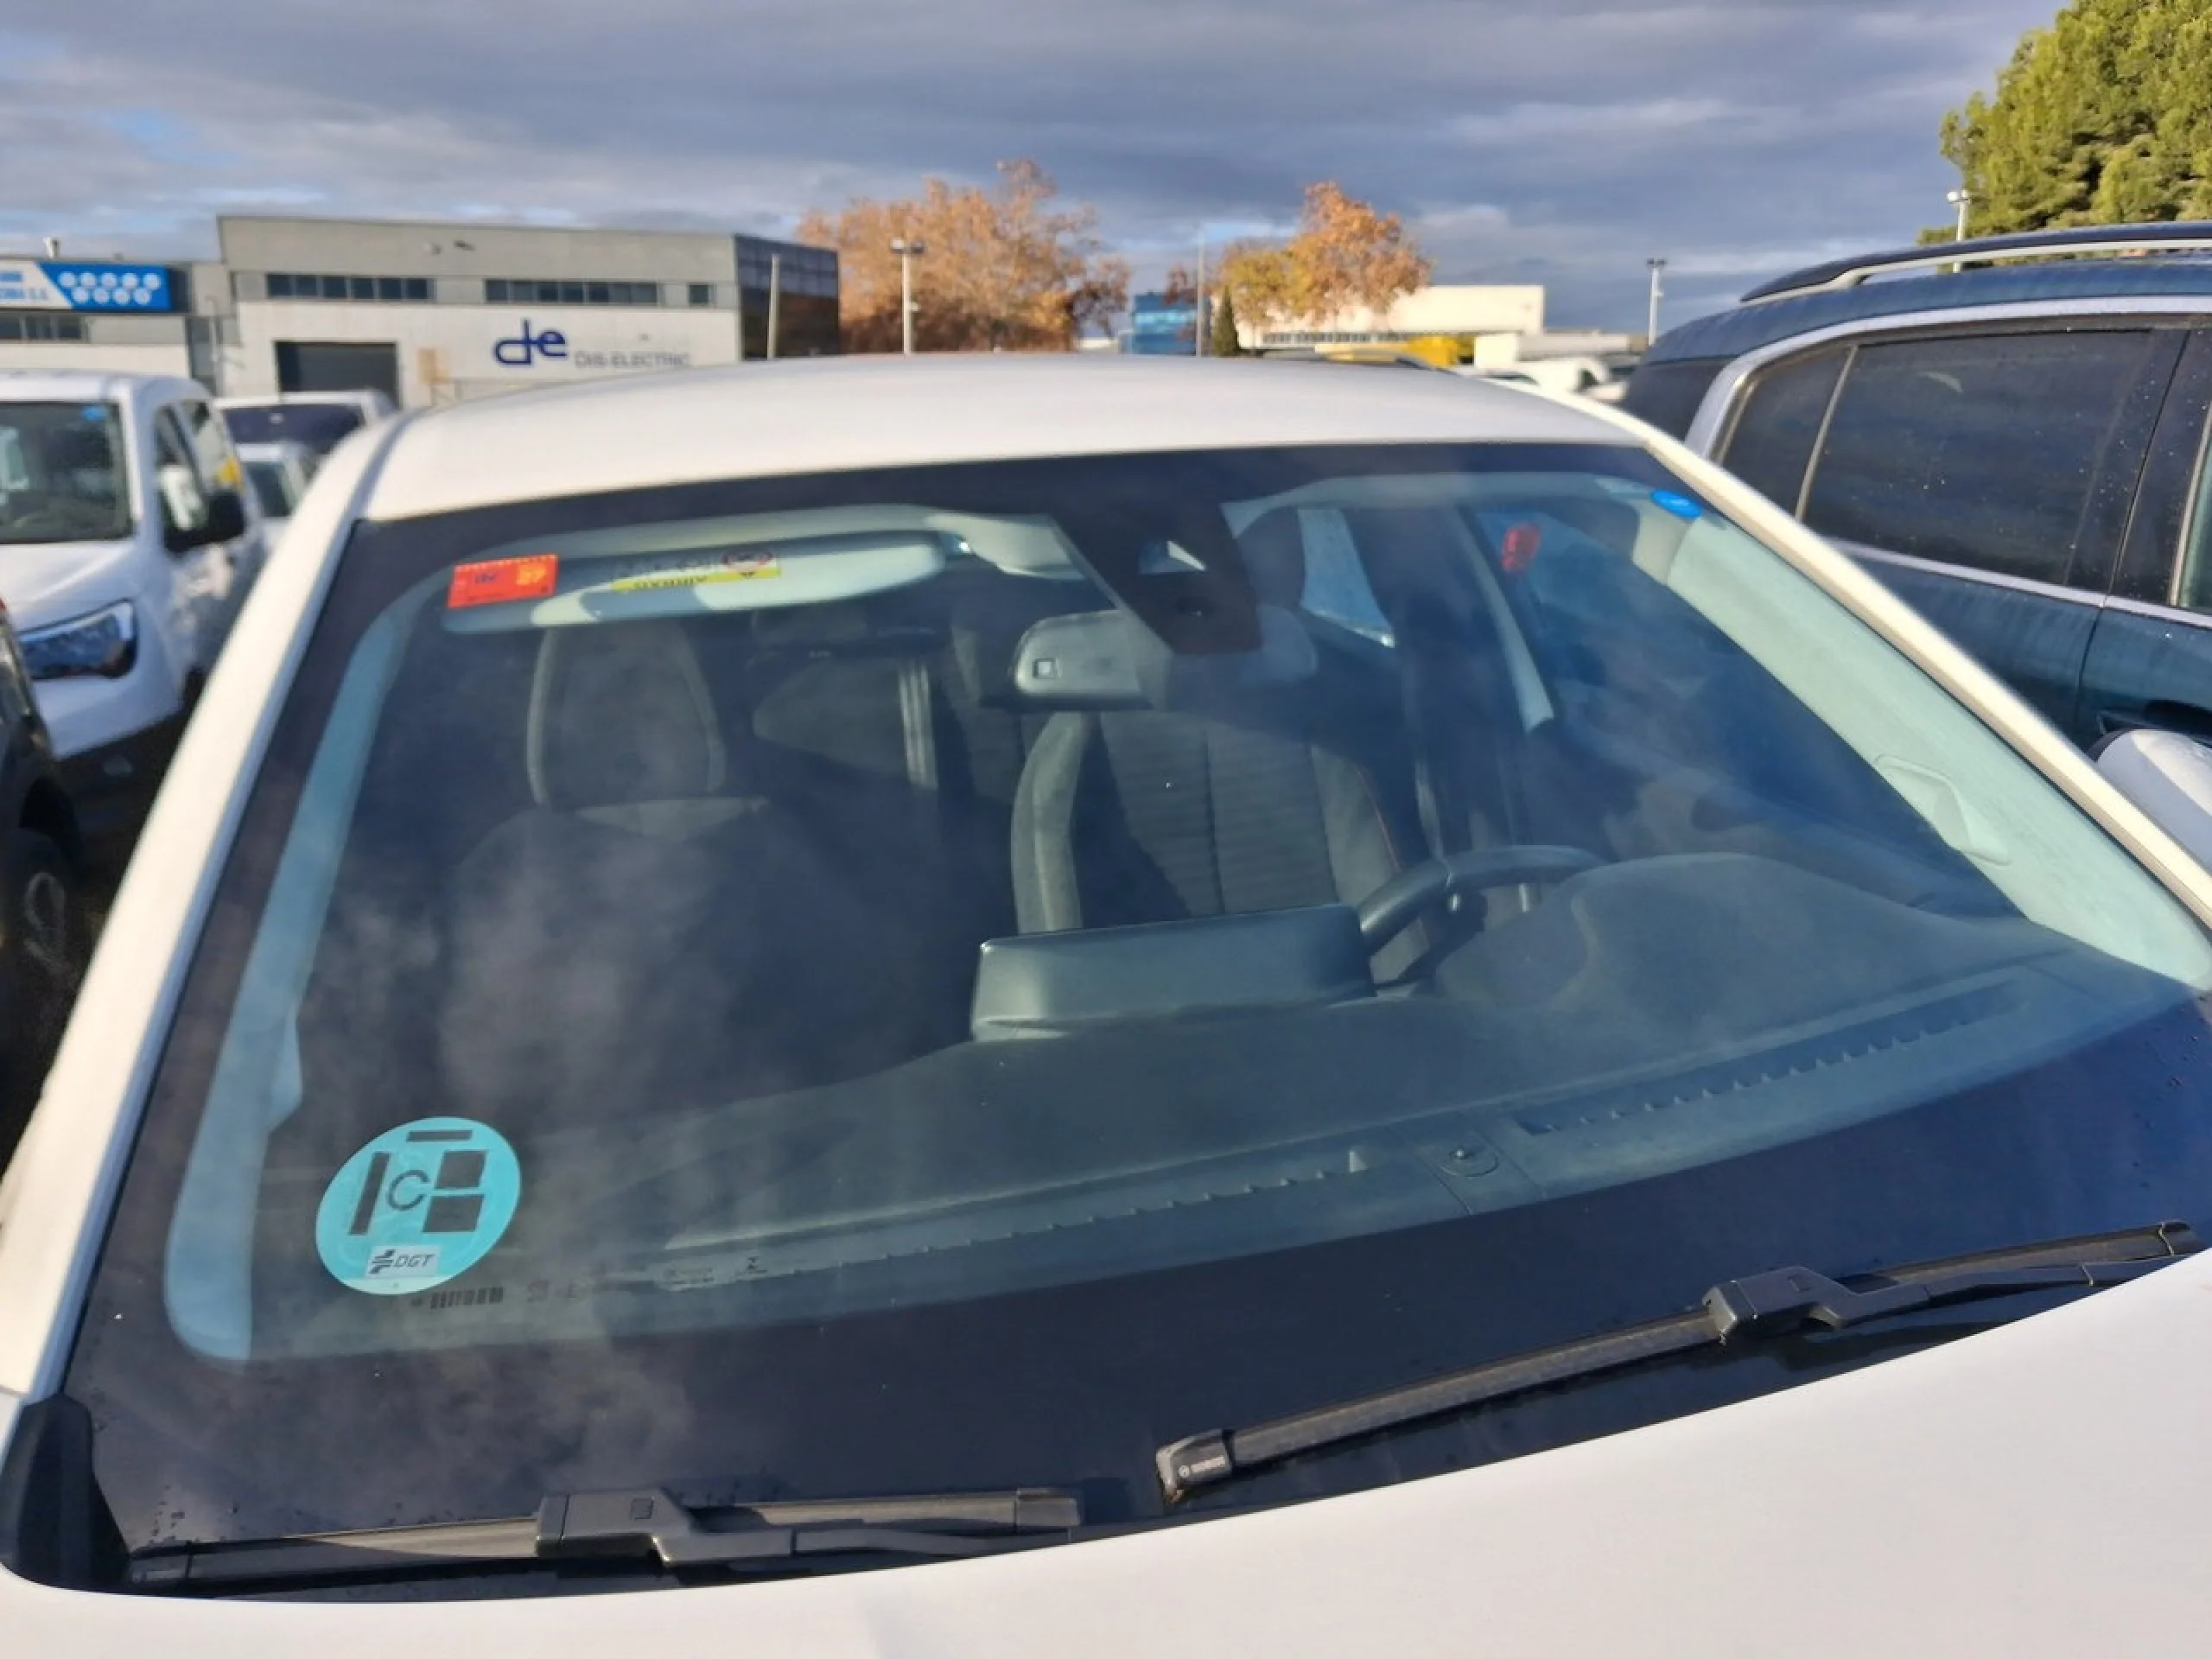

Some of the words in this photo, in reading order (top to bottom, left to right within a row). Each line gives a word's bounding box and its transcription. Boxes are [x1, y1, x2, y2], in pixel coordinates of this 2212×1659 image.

[494, 318, 568, 365] de
[387, 1170, 429, 1211] C
[393, 1254, 434, 1268] DGT
